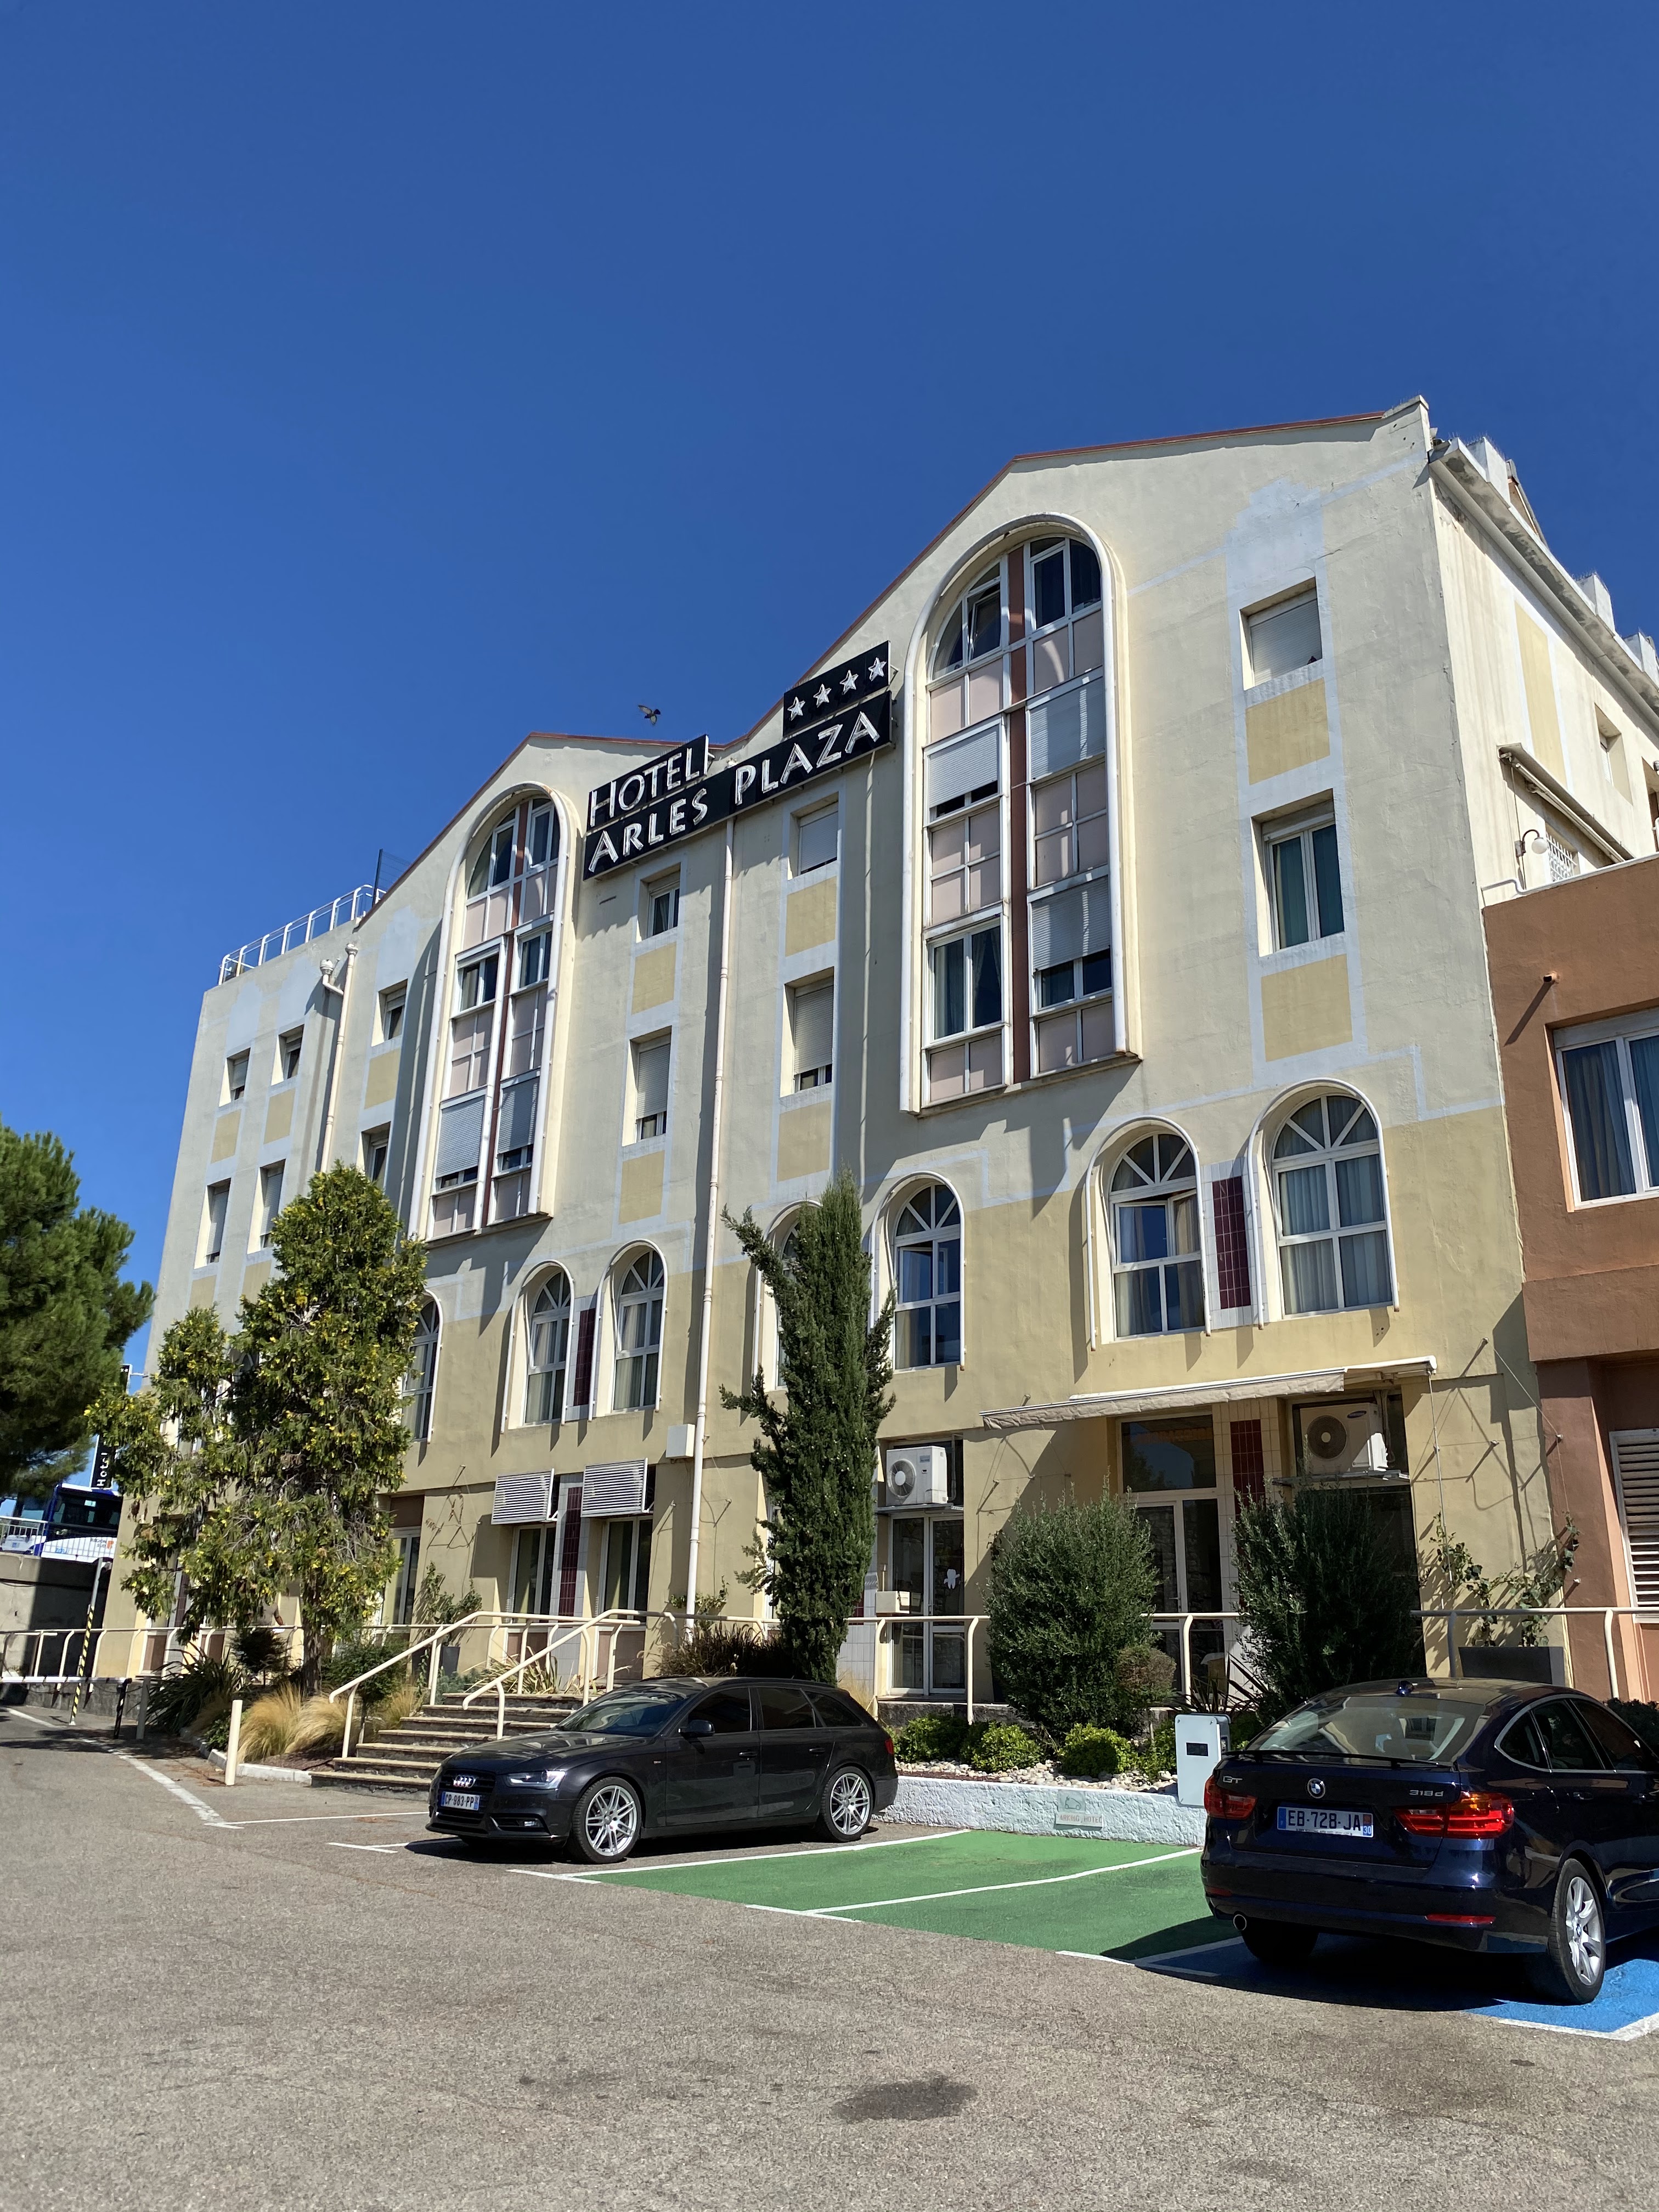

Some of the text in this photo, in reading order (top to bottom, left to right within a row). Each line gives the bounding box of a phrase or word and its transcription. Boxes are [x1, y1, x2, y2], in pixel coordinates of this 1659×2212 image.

[588, 711, 881, 873] ARLES PLAZA
[590, 747, 701, 827] HOTEL
[1223, 1775, 1243, 1784] GT
[445, 1793, 474, 1808] CP-983-PP
[1288, 1810, 1361, 1831] EB-728-JA
[1363, 1825, 1372, 1834] 30
